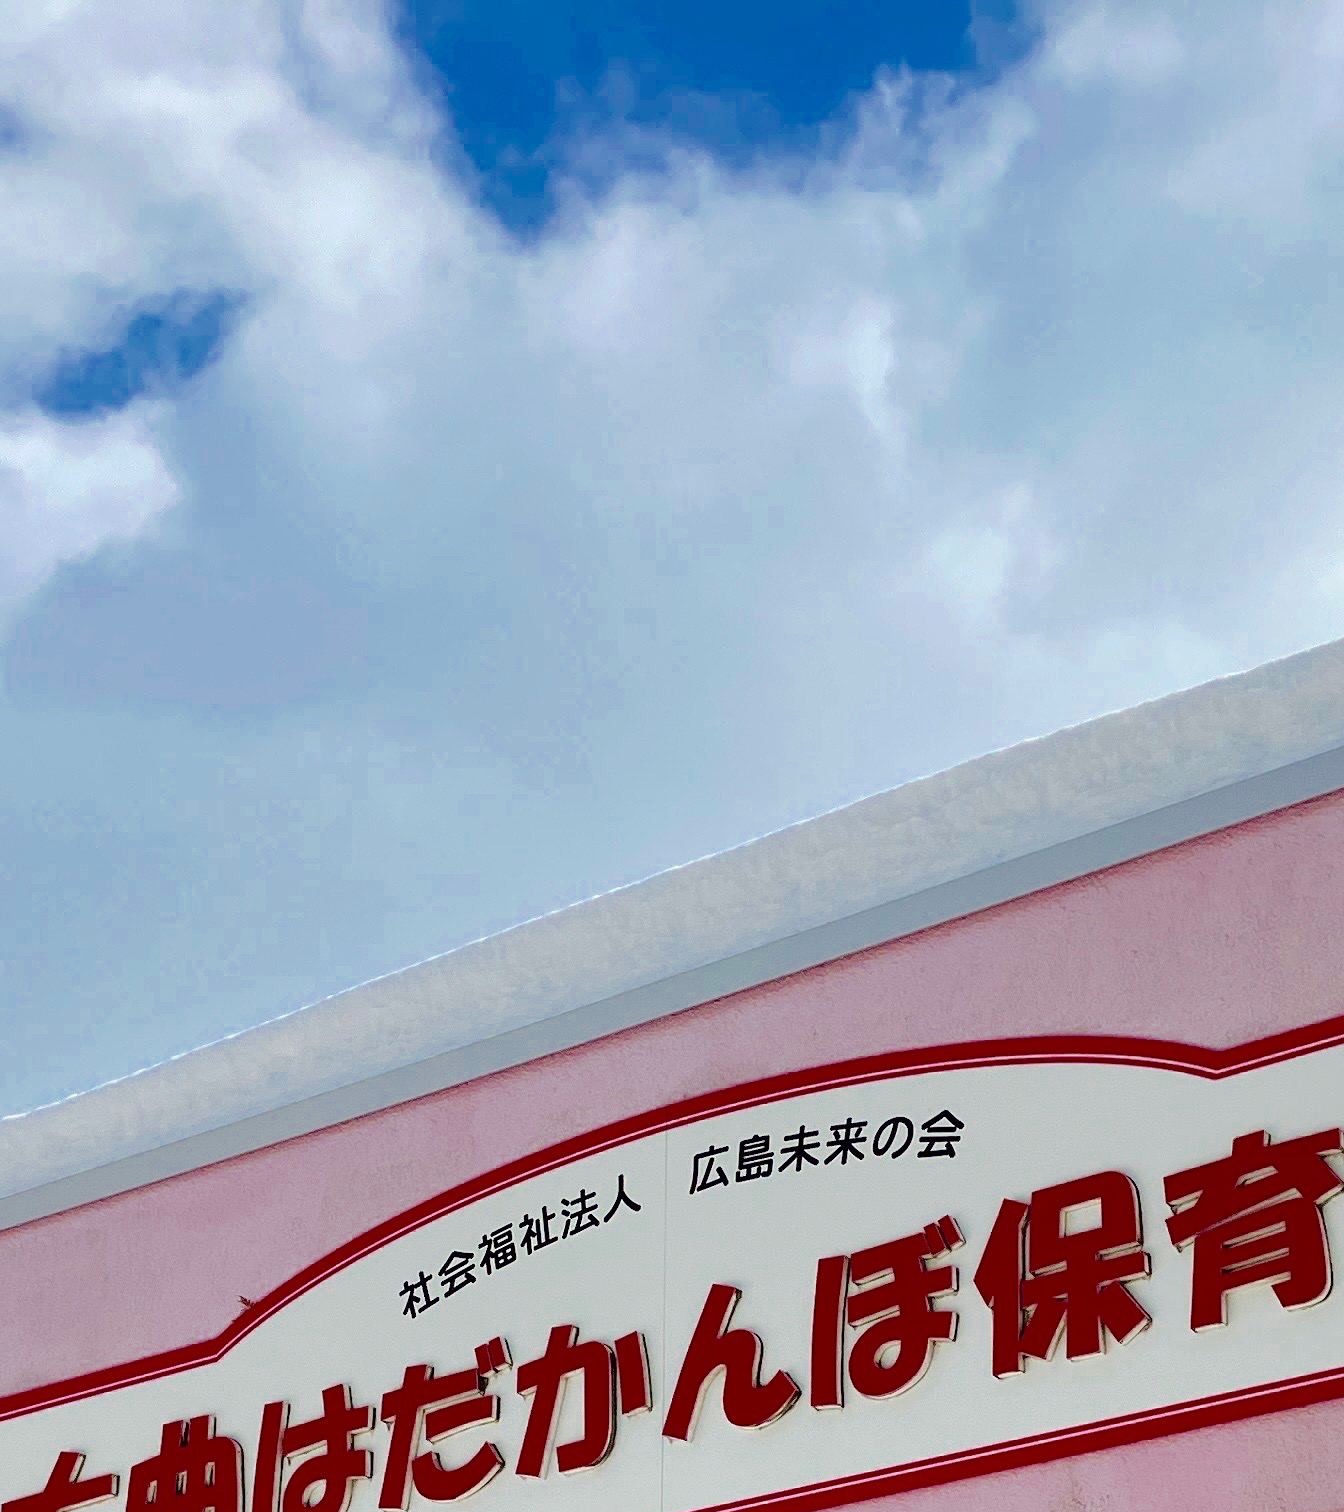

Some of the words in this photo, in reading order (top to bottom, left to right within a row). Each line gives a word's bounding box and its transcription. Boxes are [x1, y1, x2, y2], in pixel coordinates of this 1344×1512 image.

[398, 1172, 643, 1320] 社会福祉法人
[688, 1108, 966, 1196] 広島未来の会
